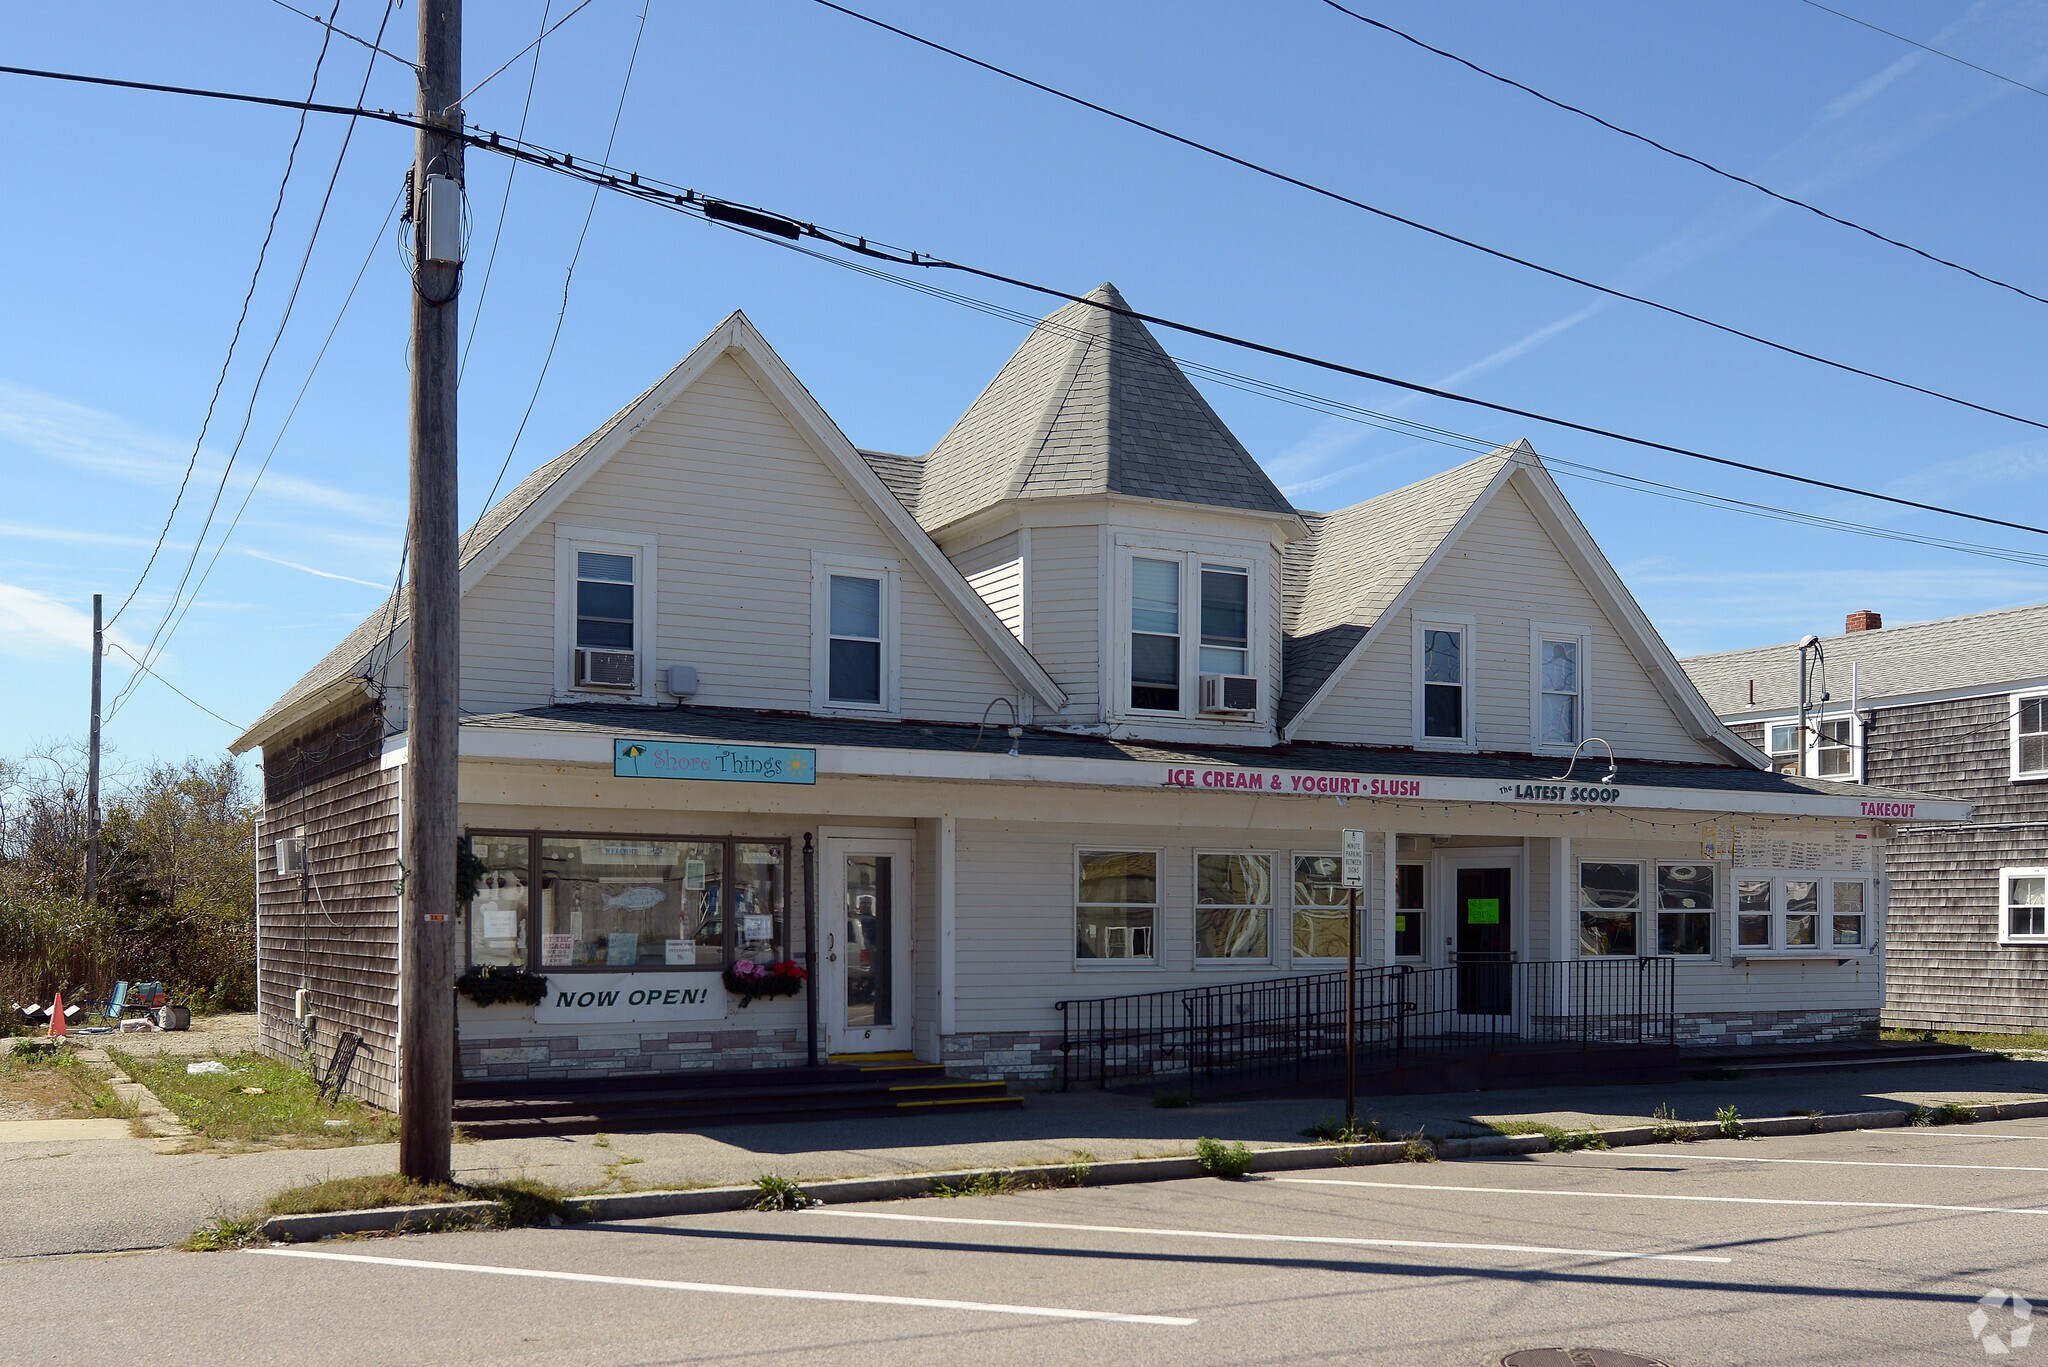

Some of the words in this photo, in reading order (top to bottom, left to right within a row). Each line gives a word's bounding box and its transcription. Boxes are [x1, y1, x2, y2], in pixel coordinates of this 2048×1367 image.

[653, 749, 711, 771] Shore
[715, 750, 783, 778] Things
[1167, 768, 1195, 786] ICE
[1202, 770, 1263, 790] CREAM
[1270, 774, 1282, 790] &
[1291, 775, 1360, 794] YOGURT
[1371, 778, 1420, 797] SLUSH
[1499, 785, 1513, 795] The
[1514, 784, 1567, 800] LATEST
[1570, 786, 1620, 803] SCOOP
[1860, 801, 1916, 817] TAKEOUT
[1346, 850, 1361, 858] PARKING
[1346, 858, 1362, 866] BETWEEN
[1347, 866, 1360, 874] SIGNS
[556, 990, 621, 1008] NOW
[628, 988, 708, 1006] OPEN!
[864, 1029, 872, 1039] 6
